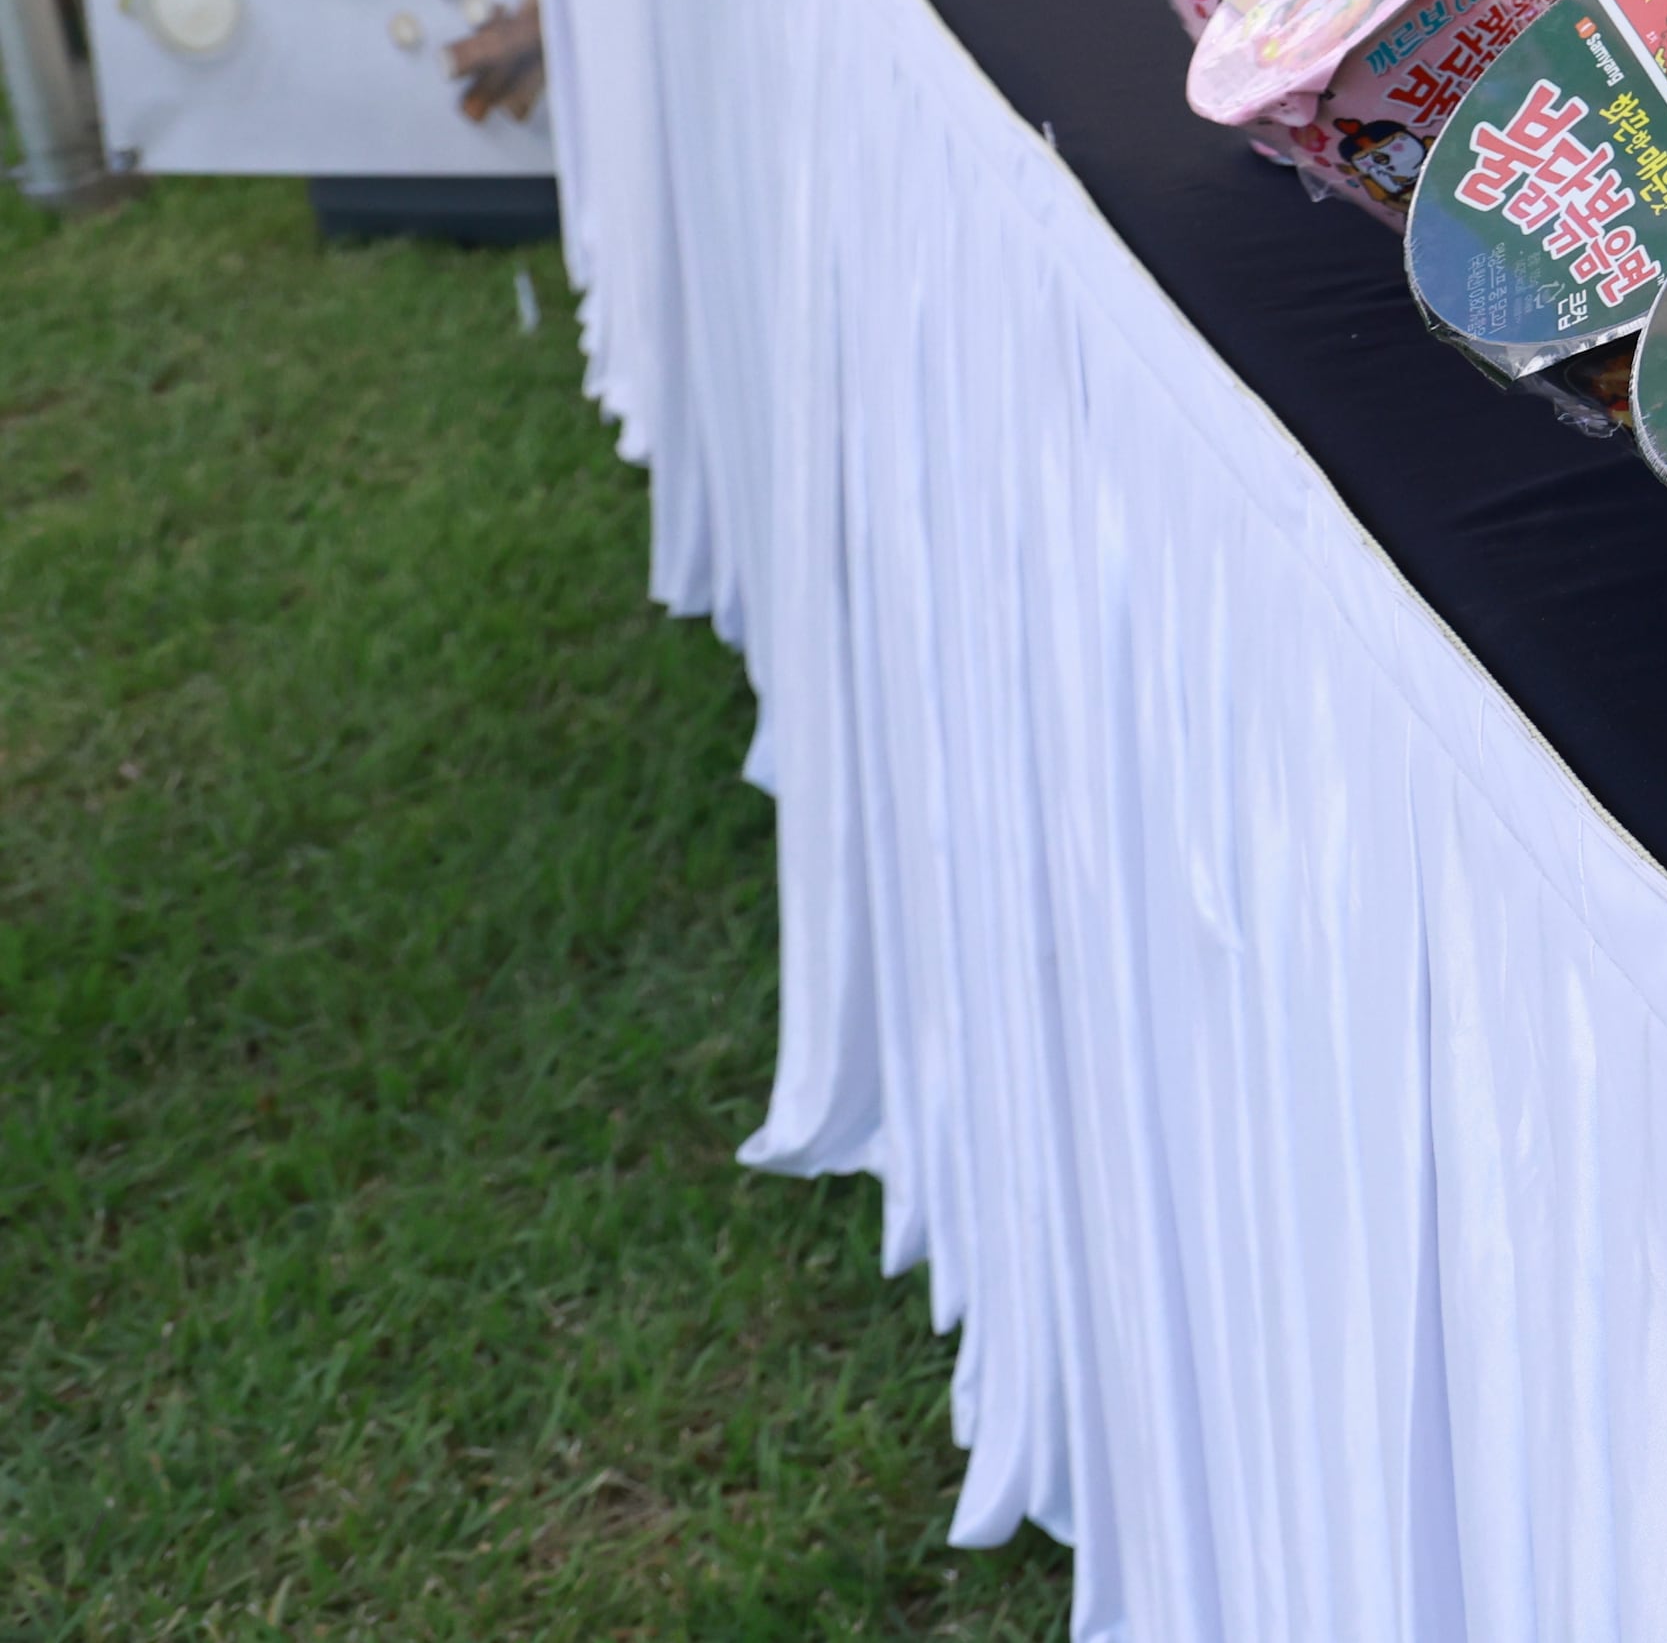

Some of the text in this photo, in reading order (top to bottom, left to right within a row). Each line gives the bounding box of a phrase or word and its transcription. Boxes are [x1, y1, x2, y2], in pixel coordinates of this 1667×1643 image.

[1583, 30, 1626, 87] Samyang
[1599, 89, 1651, 153] 화끈한
[1453, 77, 1665, 308] 불닭볶음면
[1557, 290, 1590, 332] 큰컵
